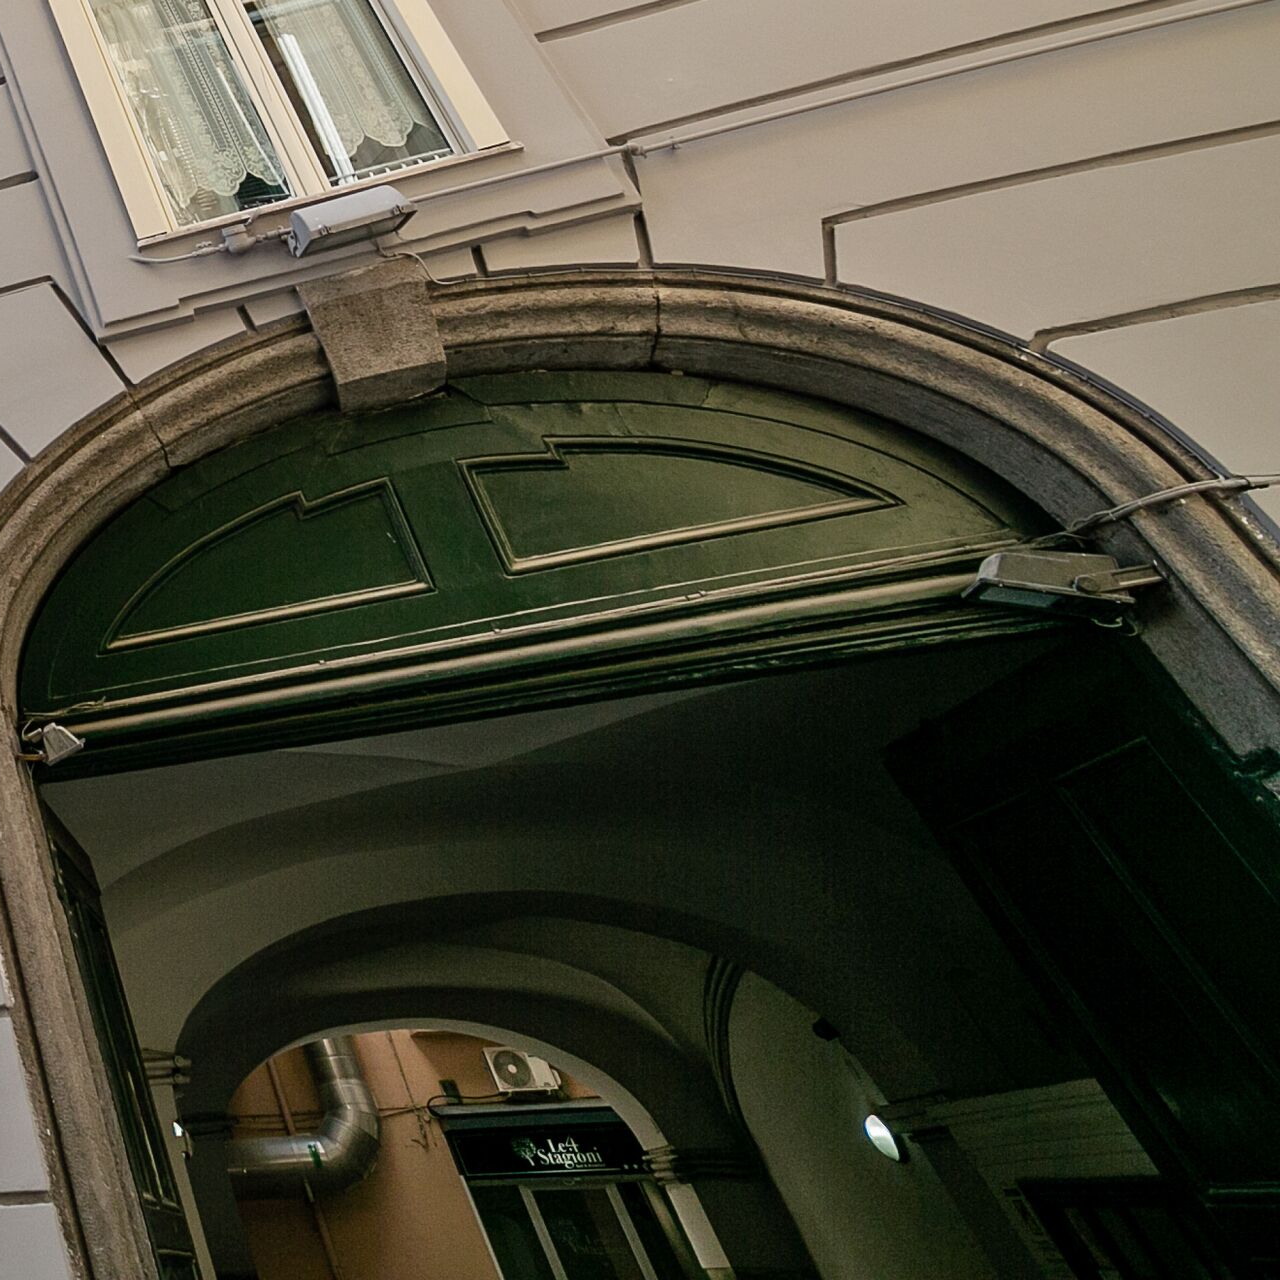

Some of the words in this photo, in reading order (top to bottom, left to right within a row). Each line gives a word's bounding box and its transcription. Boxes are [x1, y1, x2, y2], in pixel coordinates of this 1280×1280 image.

[546, 1138, 566, 1153] Le
[565, 1135, 579, 1153] 4
[536, 1146, 603, 1169] Stagioni
